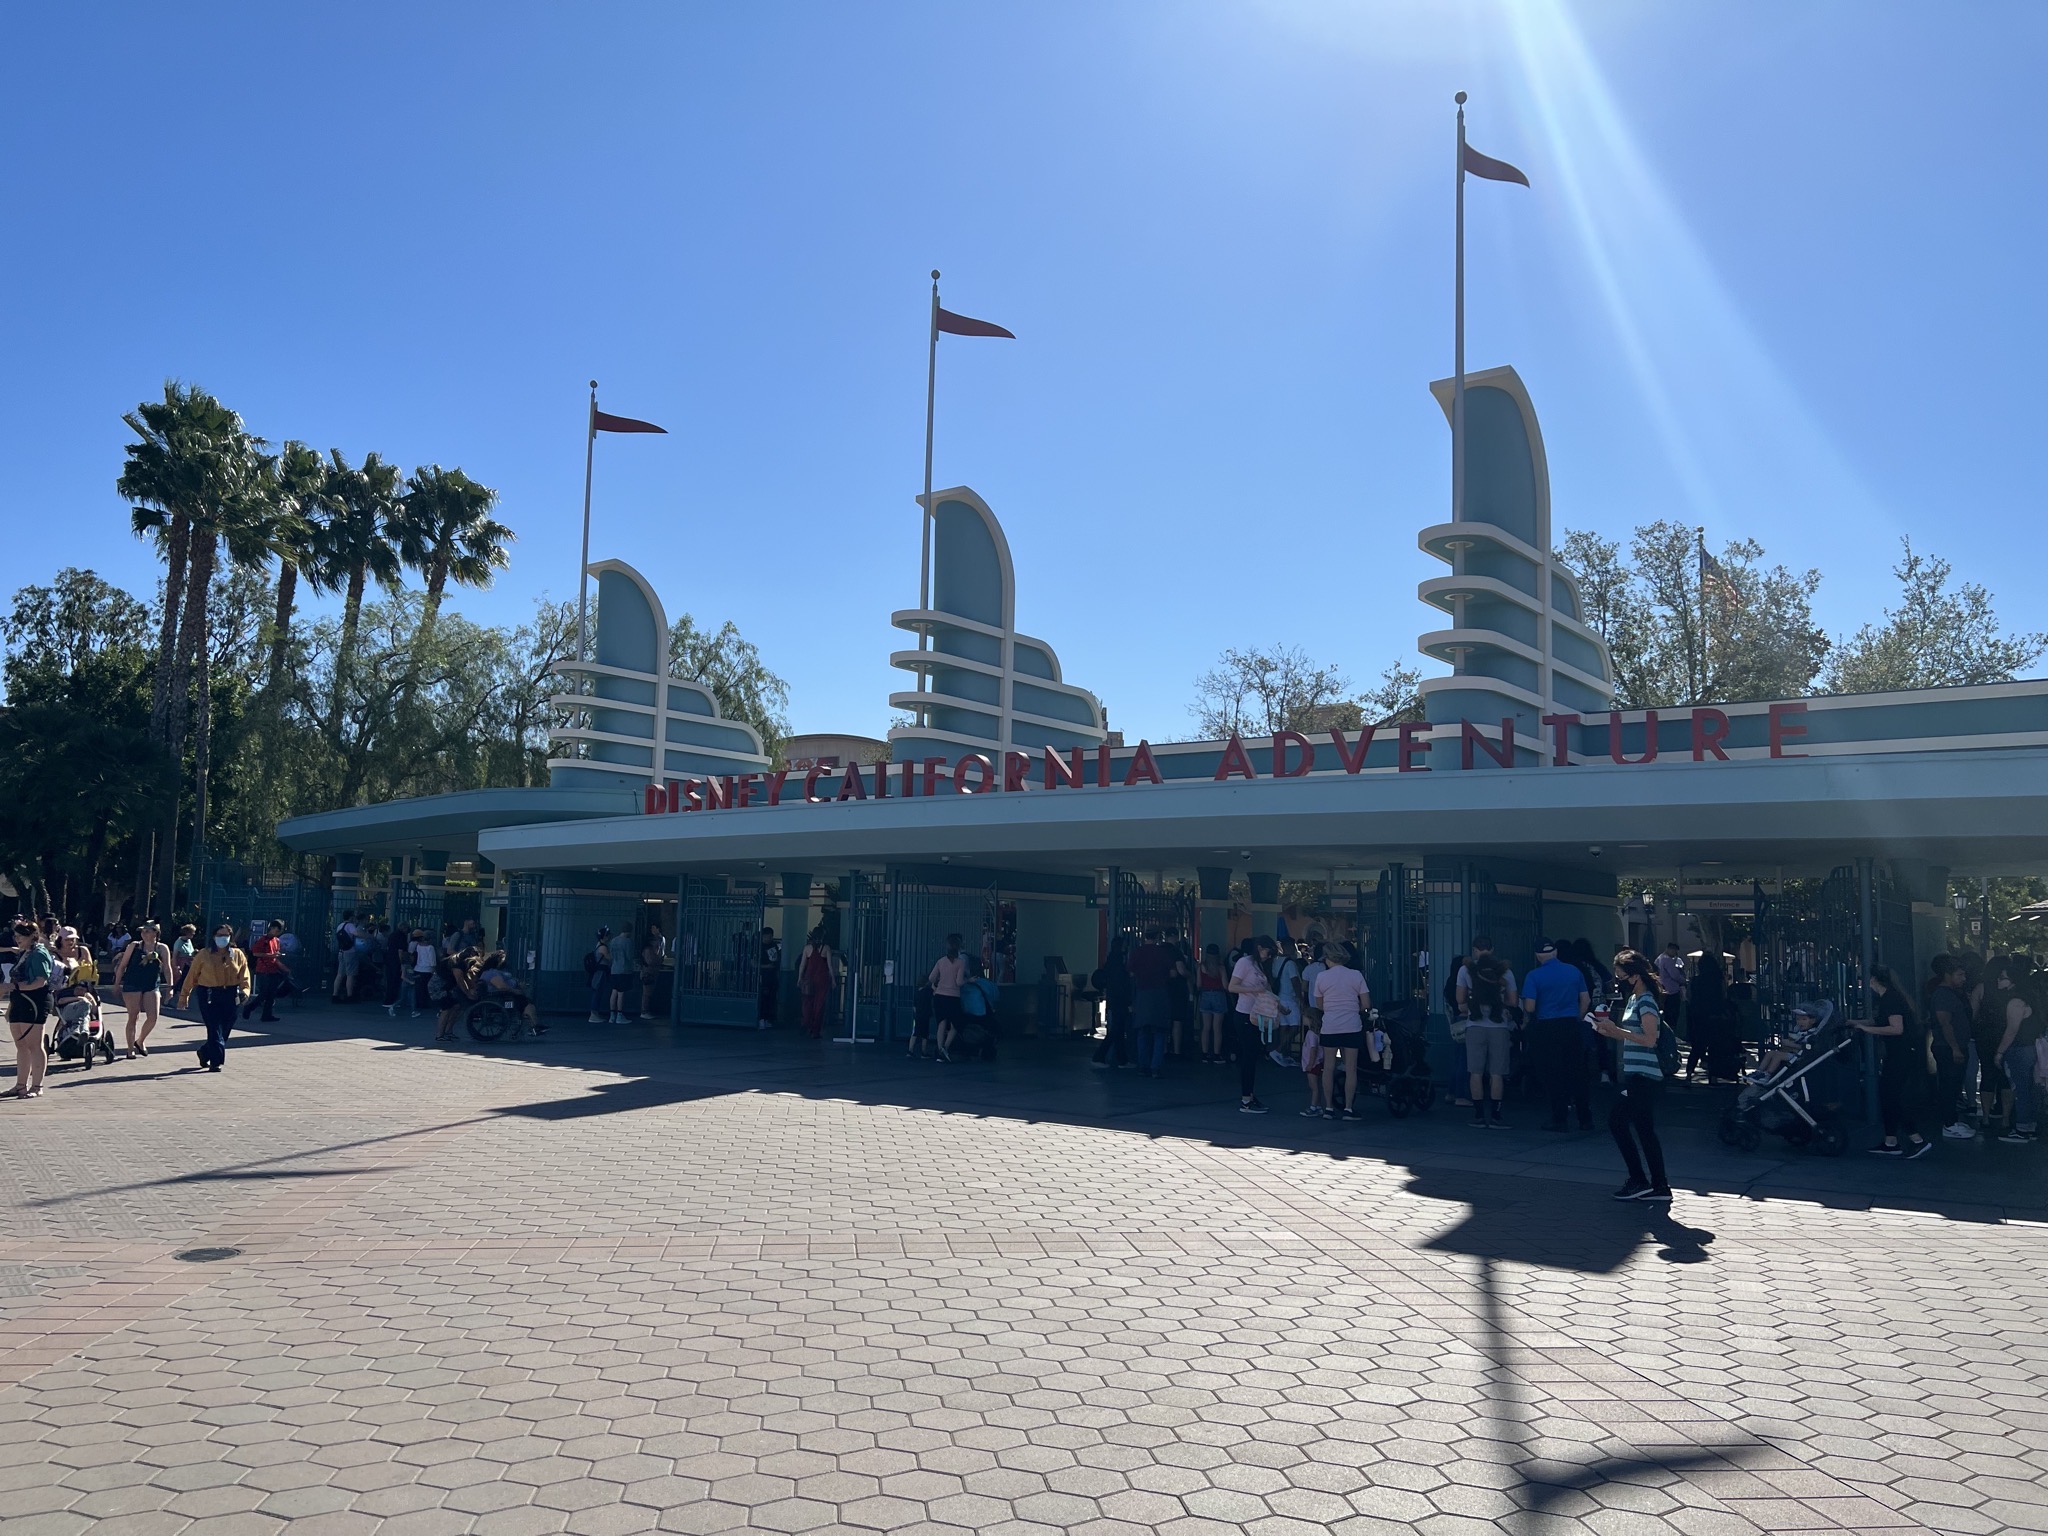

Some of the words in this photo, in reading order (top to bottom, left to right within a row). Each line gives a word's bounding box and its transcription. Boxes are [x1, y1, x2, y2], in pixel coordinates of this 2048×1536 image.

[645, 771, 788, 815] DISNEY
[803, 739, 1164, 804] CALIFORNIA
[1214, 702, 1809, 782] ADVENTURE
